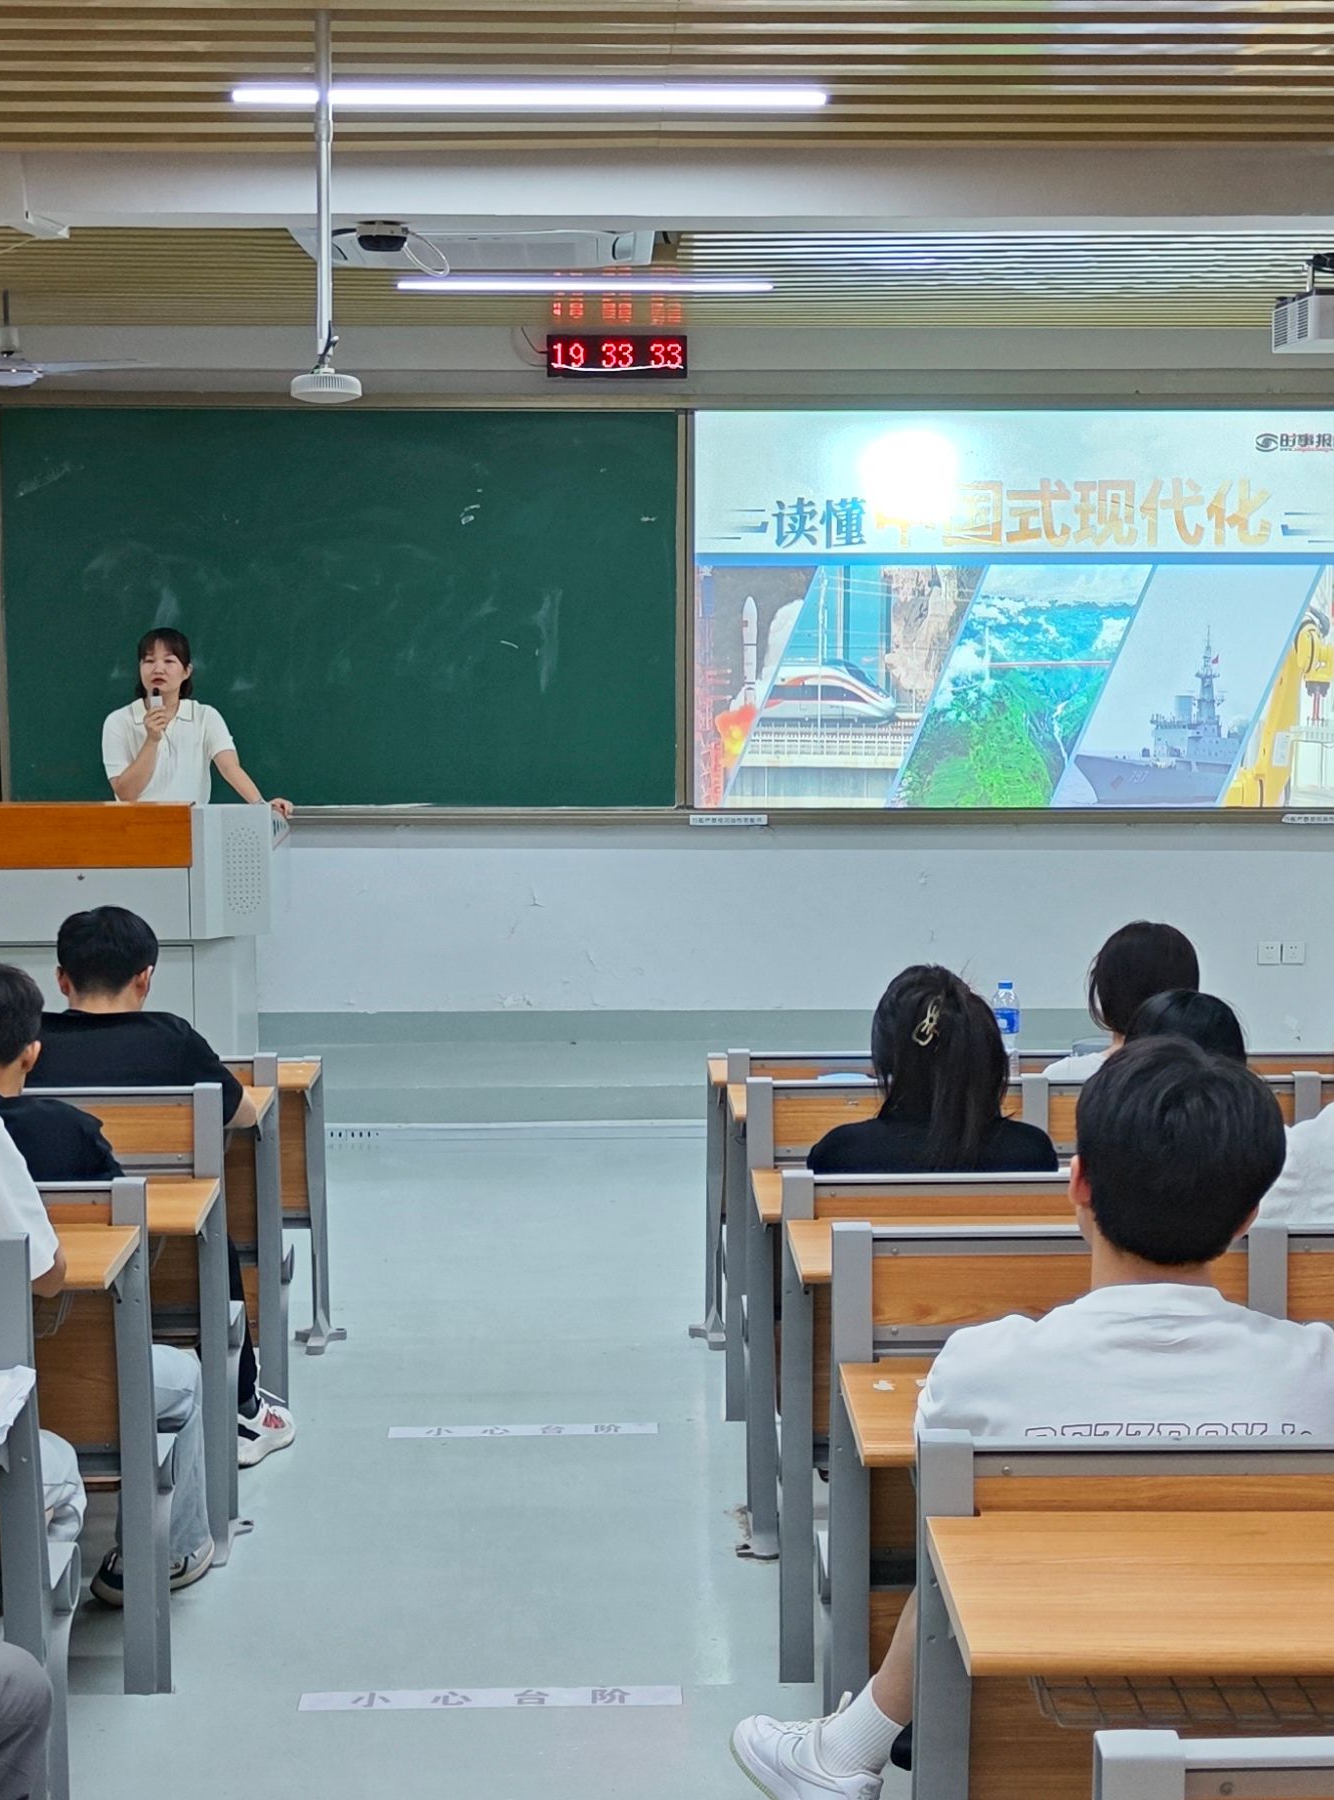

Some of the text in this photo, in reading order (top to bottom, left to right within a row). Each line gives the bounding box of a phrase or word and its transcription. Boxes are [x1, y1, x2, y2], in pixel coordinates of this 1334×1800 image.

[553, 343, 682, 368] 19 33 33
[425, 1422, 622, 1436] 小心台阶
[351, 1685, 630, 1707] 小心台阶
